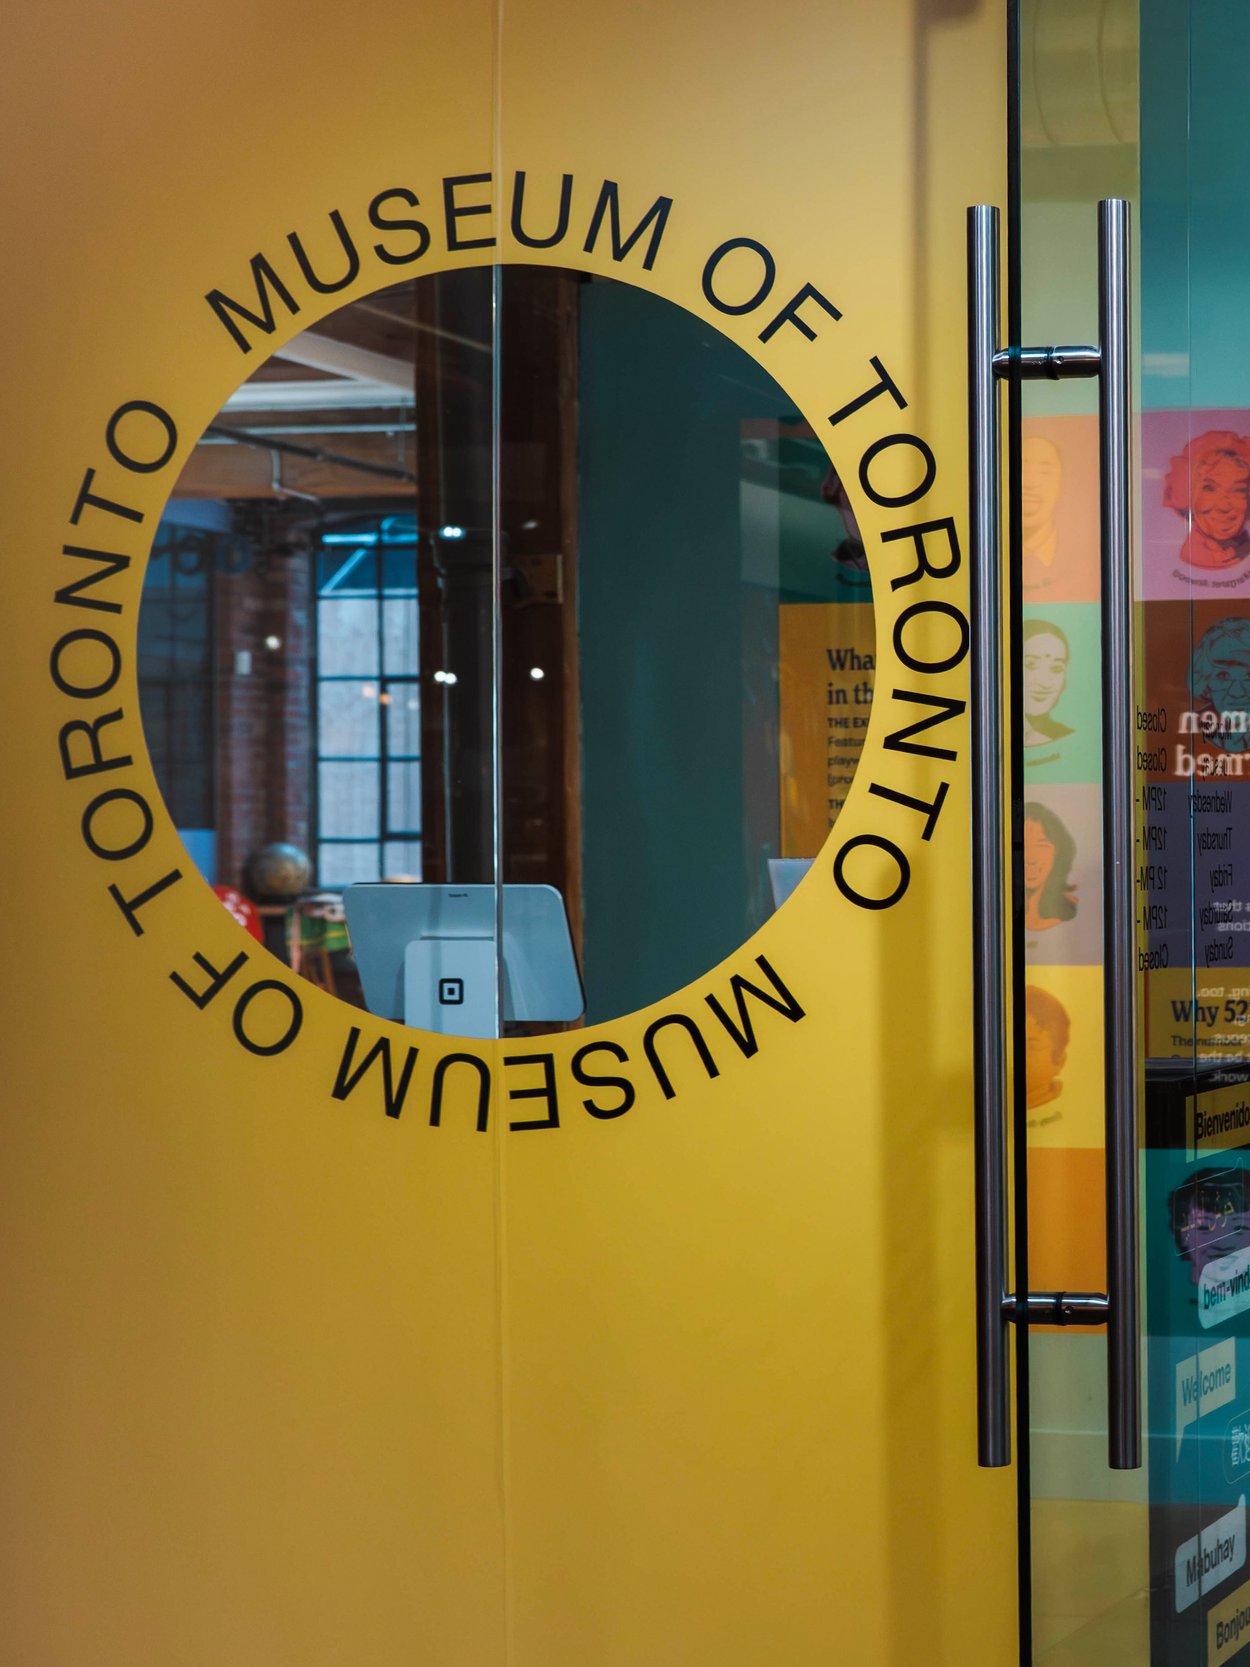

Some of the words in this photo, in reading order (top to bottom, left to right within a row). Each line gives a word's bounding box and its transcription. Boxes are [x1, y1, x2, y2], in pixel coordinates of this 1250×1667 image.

[204, 170, 674, 354] MUSEUM
[702, 237, 843, 344] OF
[827, 355, 970, 911] TORONTO
[49, 400, 183, 937] TORONTO
[827, 682, 848, 705] in
[827, 717, 850, 729] THE
[168, 951, 303, 1057] OF
[1171, 999, 1220, 1027] Why
[331, 954, 806, 1133] MUSEUM
[1196, 1101, 1250, 1140] Bienvenido
[1181, 1363, 1231, 1407] Welcome
[1186, 1534, 1236, 1588] Mabuhay
